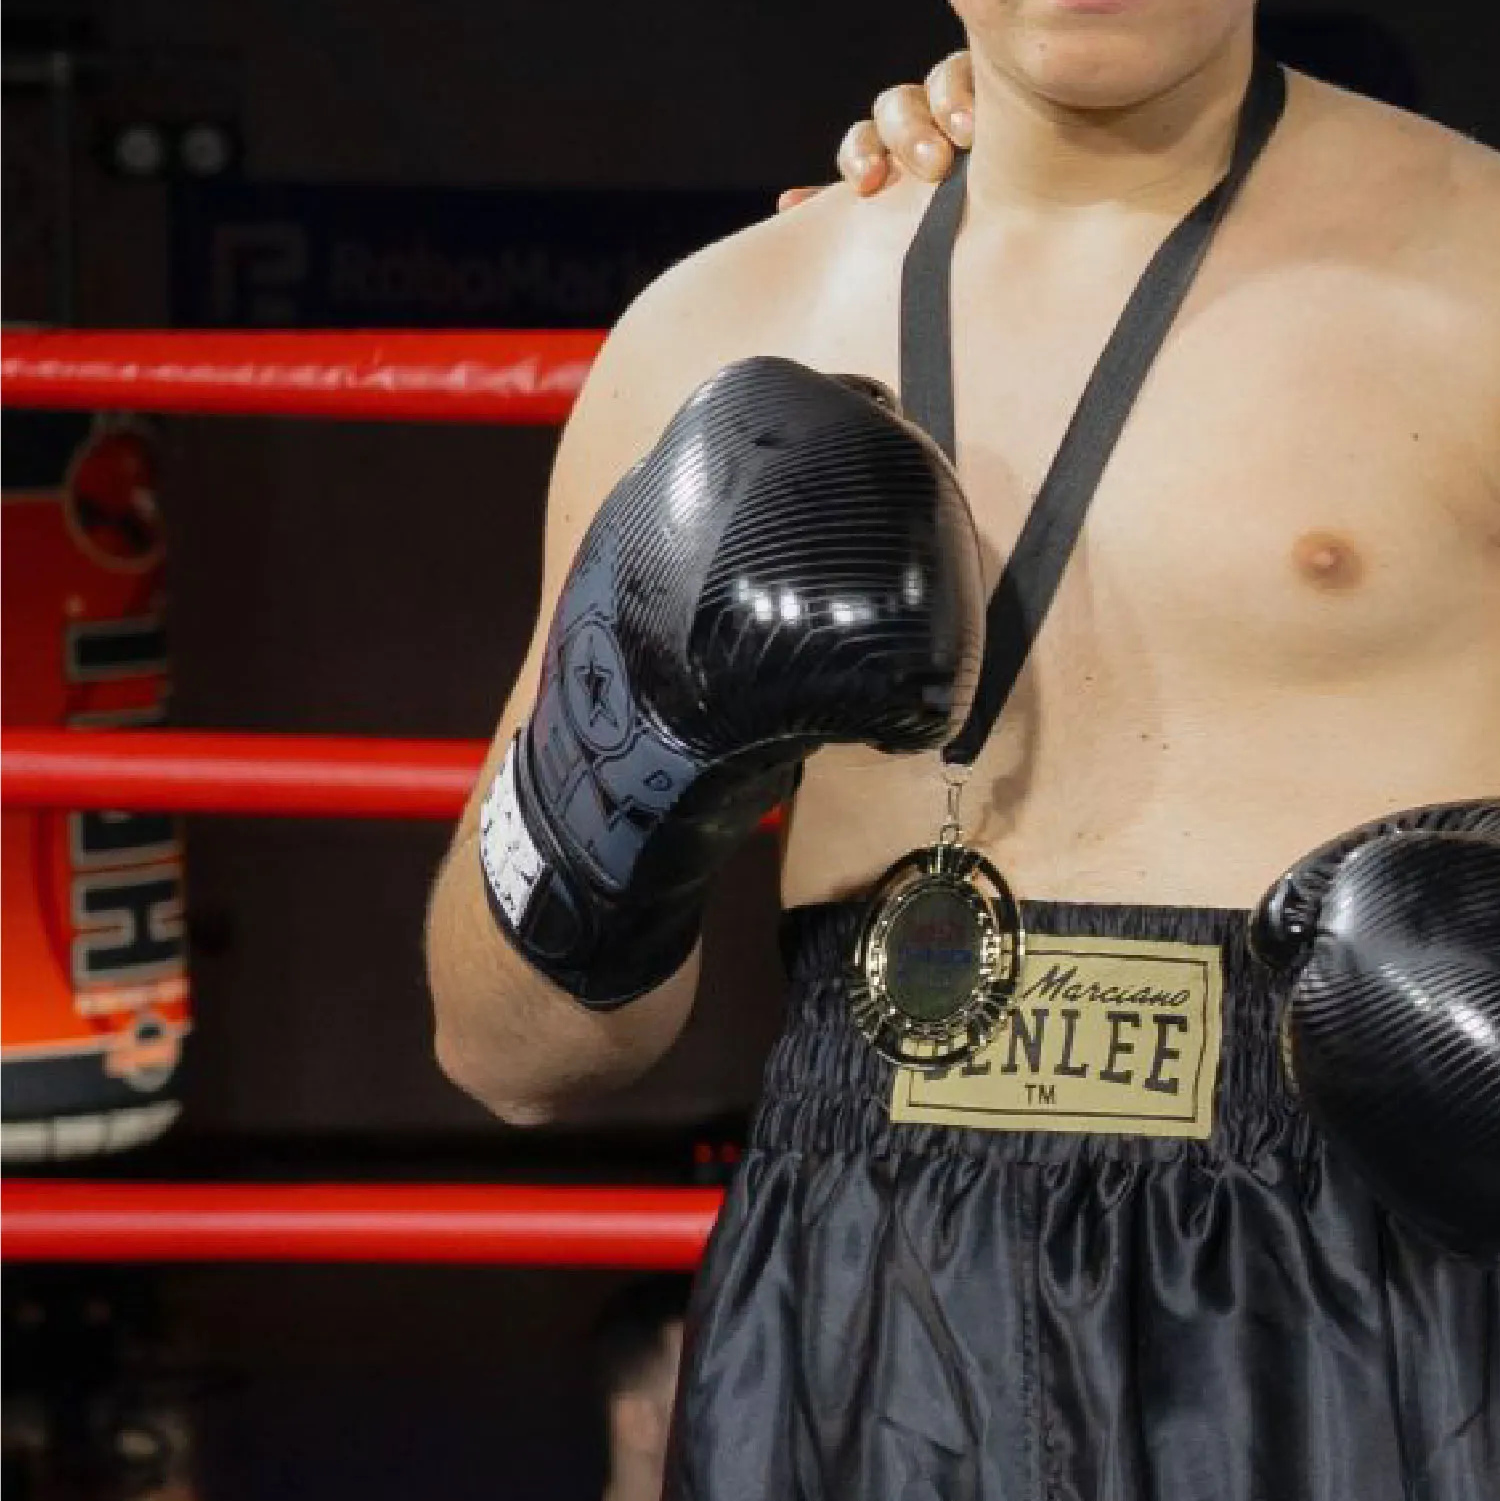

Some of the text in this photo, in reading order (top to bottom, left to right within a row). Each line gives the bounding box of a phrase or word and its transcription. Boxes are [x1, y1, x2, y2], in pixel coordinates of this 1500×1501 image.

[1022, 963, 1191, 1007] Marciano
[923, 1007, 1190, 1095] NLEE
[1024, 1083, 1057, 1106] TM
